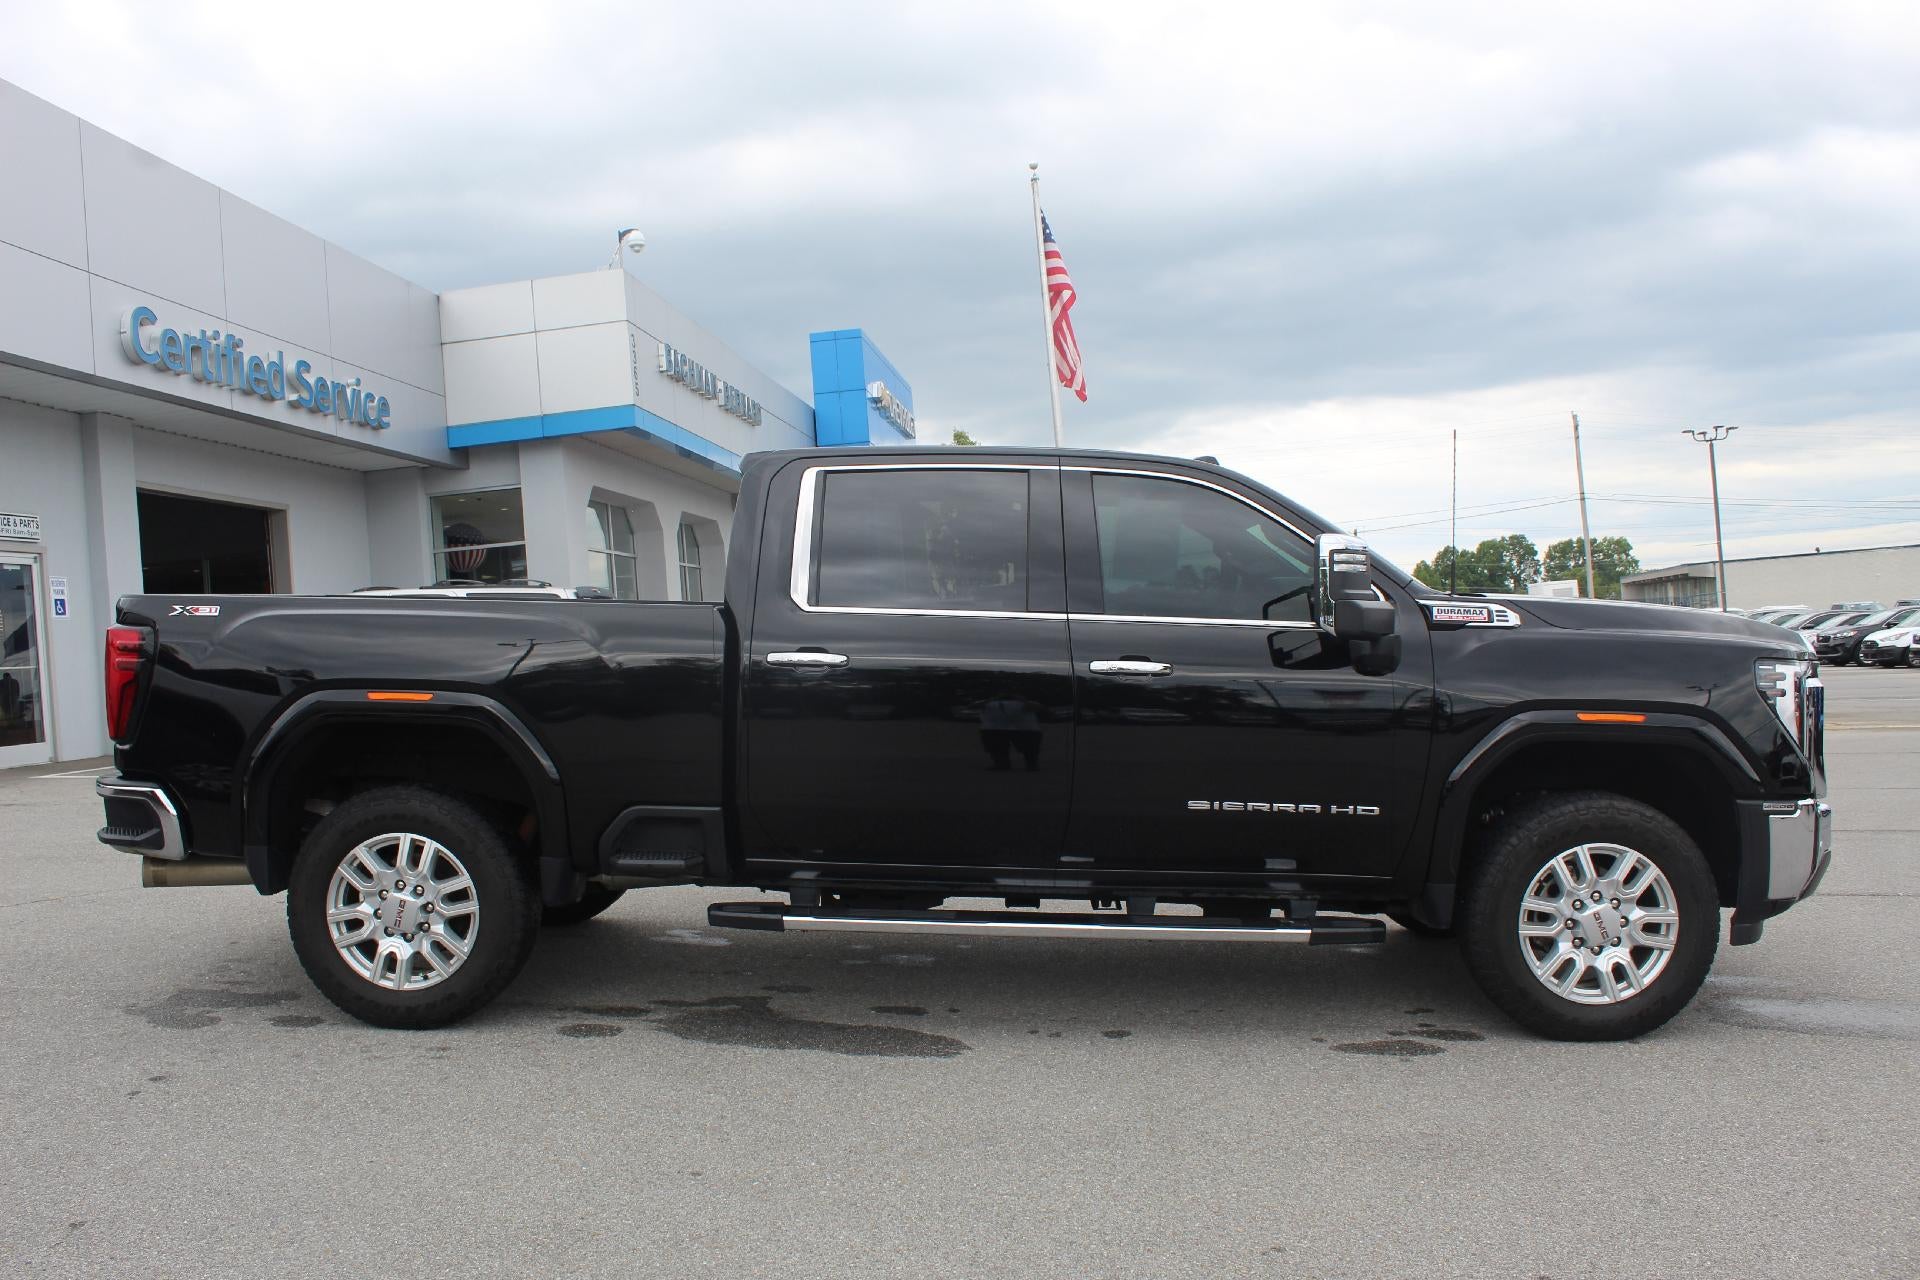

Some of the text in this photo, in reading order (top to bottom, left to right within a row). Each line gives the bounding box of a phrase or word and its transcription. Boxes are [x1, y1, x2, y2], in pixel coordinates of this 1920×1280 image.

[123, 306, 391, 430] Certified Service
[19, 518, 40, 530] PARTS
[1436, 608, 1485, 616] DURAMAX
[1187, 800, 1380, 815] SIERRA HD
[394, 899, 406, 928] GMC
[1593, 911, 1610, 940] GMC
